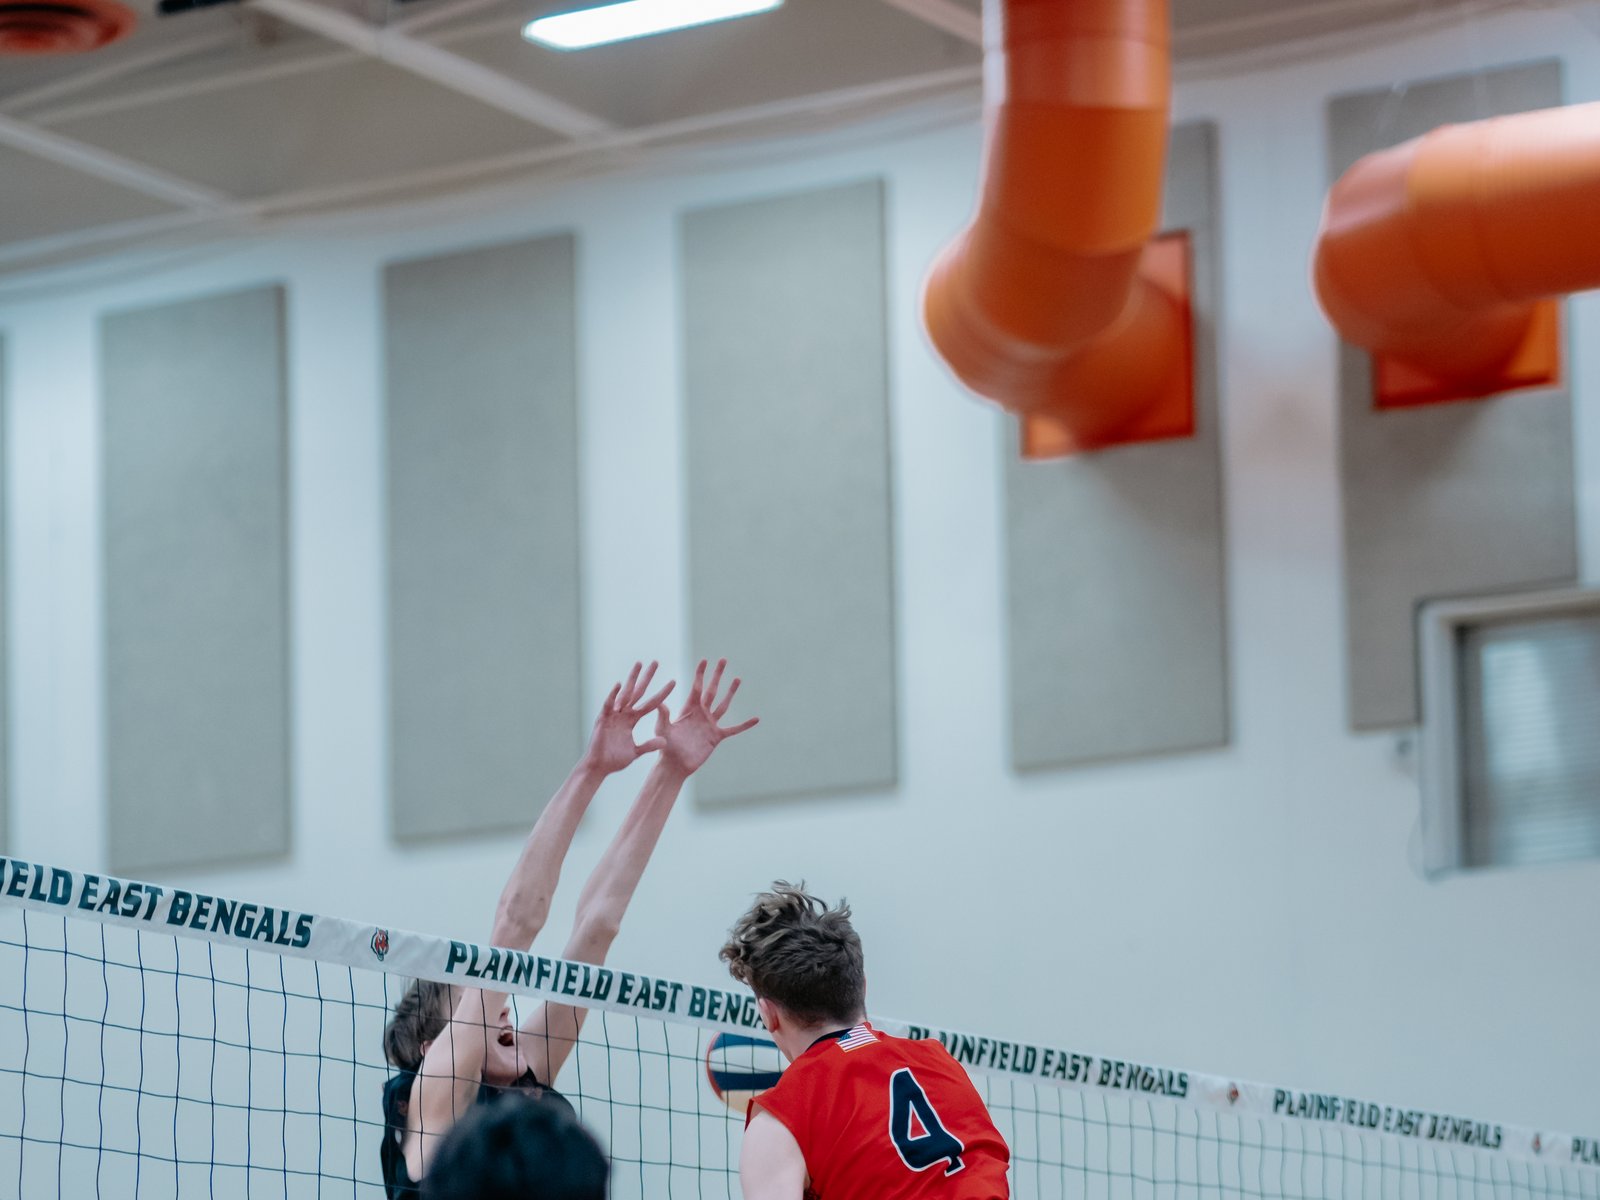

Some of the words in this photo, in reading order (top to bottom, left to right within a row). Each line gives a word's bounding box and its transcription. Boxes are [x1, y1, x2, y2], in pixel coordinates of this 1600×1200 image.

[78, 873, 163, 922] EAST
[166, 890, 314, 949] BENGALS
[445, 940, 612, 1001] PLAINFIELD
[616, 973, 683, 1013] EAST
[1040, 1048, 1094, 1084] EAST
[1096, 1058, 1189, 1099] BENGALS
[889, 1067, 965, 1177] 4
[1272, 1088, 1381, 1130] PLAINFIELD
[1383, 1105, 1426, 1138] EAST
[1427, 1112, 1502, 1149] BENGALS
